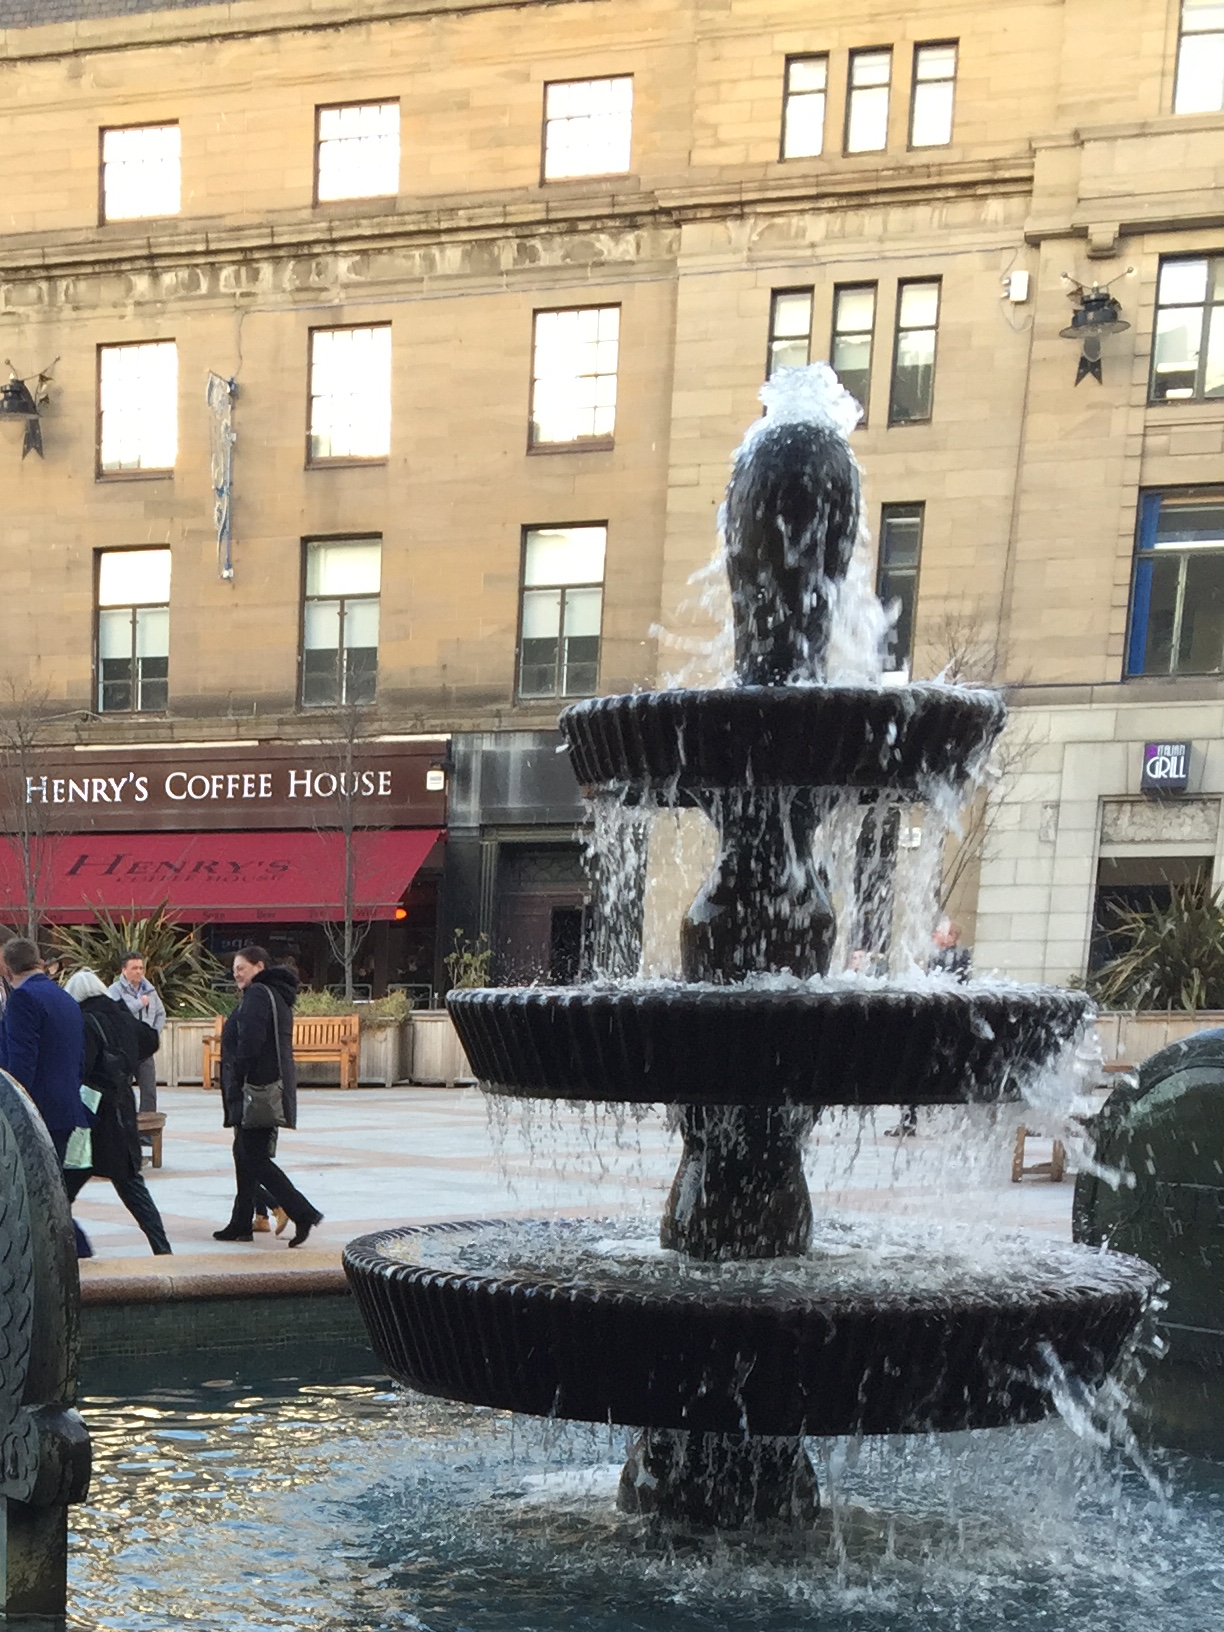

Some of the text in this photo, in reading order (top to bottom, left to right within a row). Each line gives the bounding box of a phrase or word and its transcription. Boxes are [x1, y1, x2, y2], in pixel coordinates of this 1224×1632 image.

[1157, 744, 1186, 756] ITALIAN
[1146, 755, 1187, 779] GRILL
[25, 768, 393, 804] HENRY'S COFFEE HOUSE
[64, 853, 293, 876] HENRY'S
